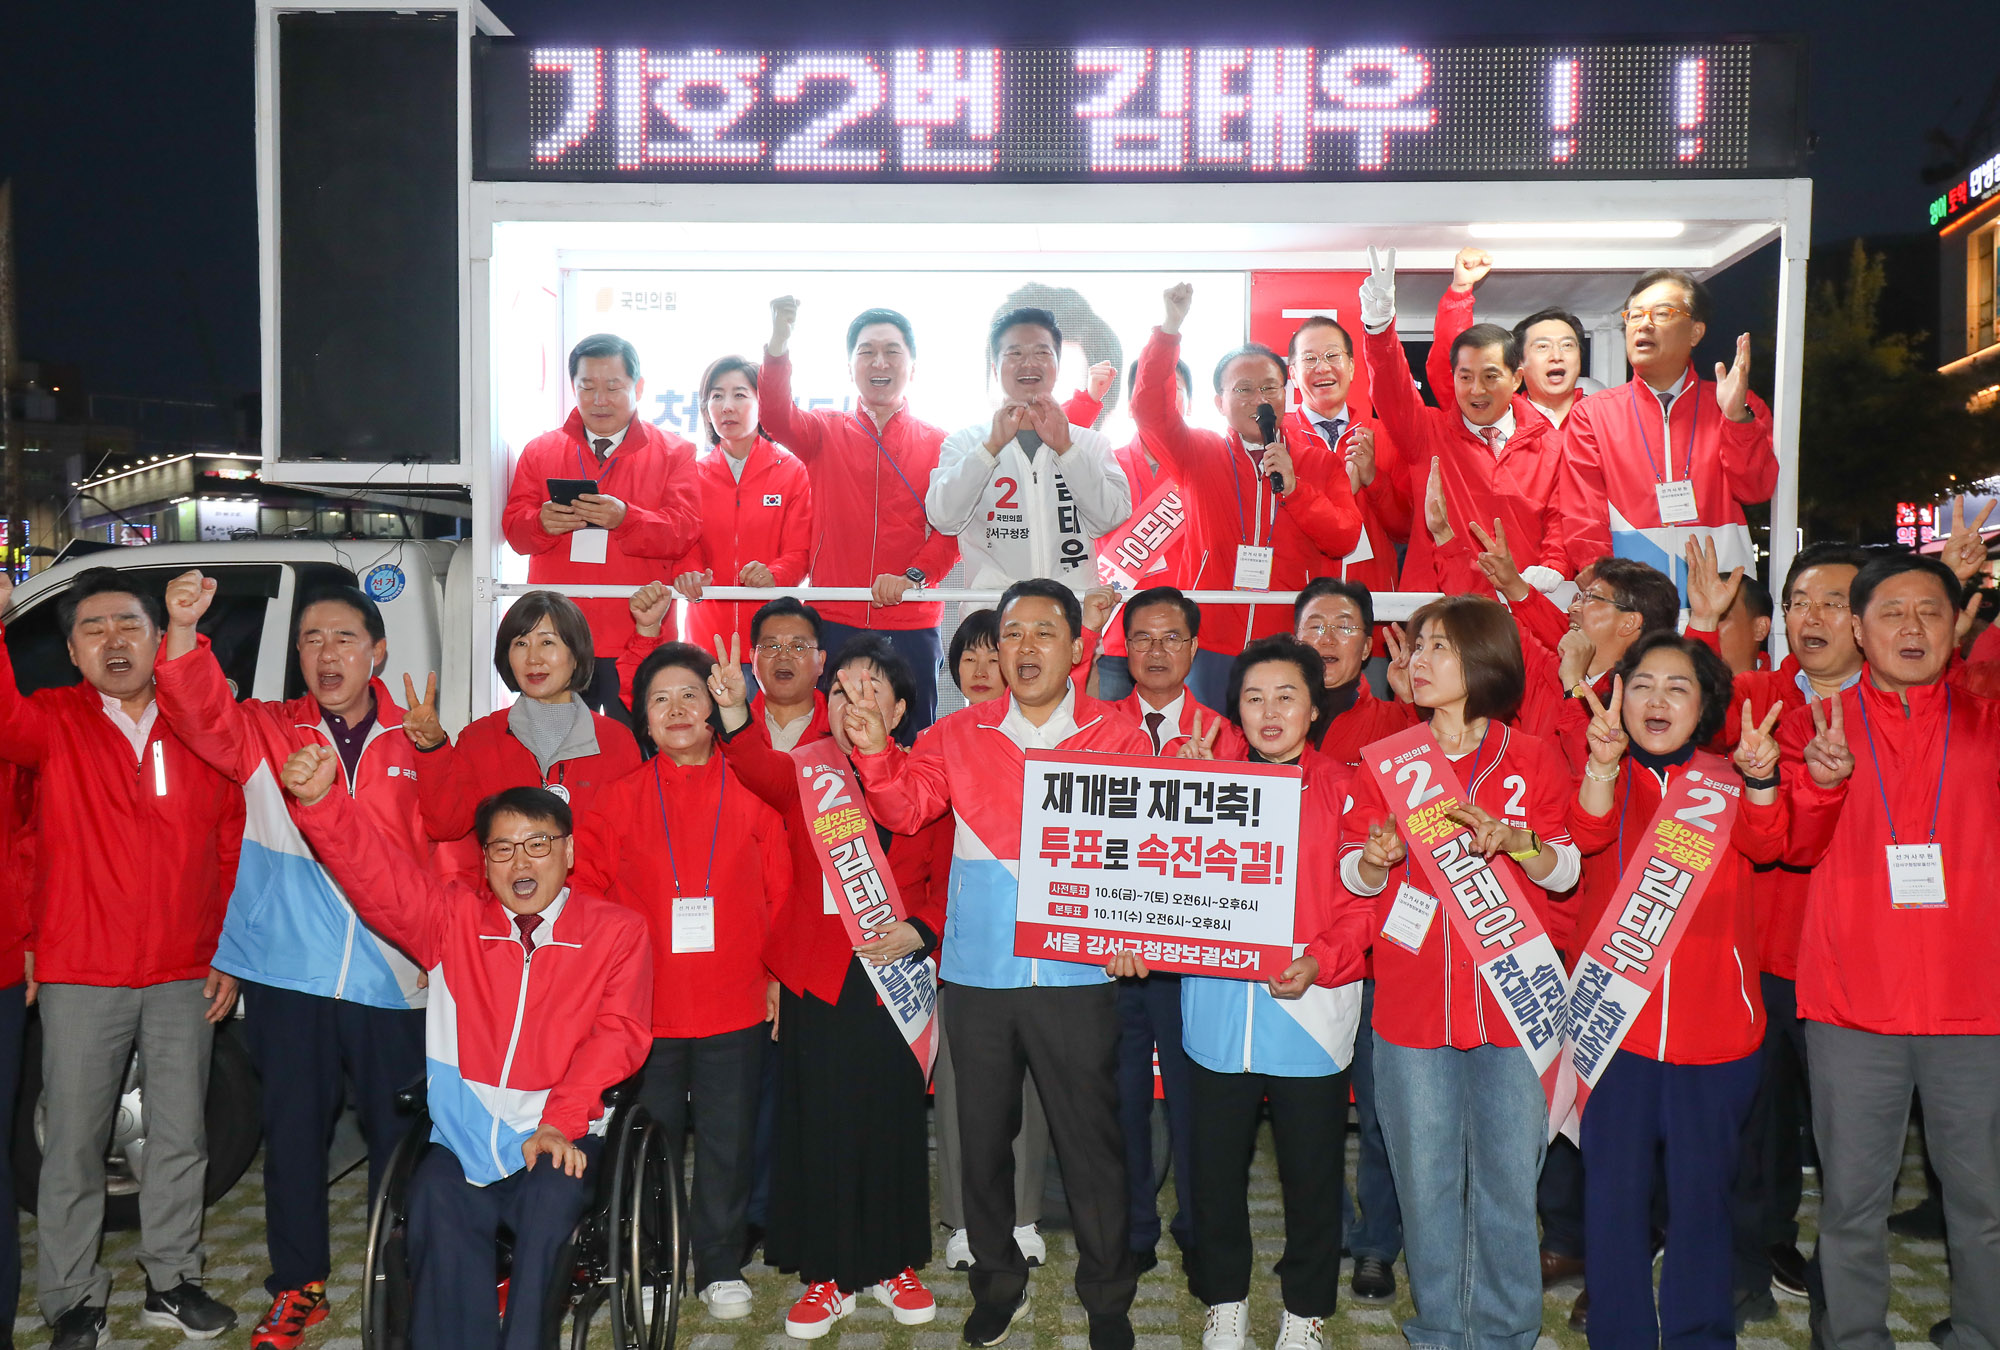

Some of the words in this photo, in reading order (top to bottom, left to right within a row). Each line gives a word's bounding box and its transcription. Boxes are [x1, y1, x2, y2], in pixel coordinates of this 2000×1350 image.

[535, 48, 999, 171] 기호2번
[1075, 46, 1437, 171] 김태우
[1930, 194, 1947, 225] 영어
[1948, 180, 1967, 213] 토익
[620, 291, 677, 311] 국민의힘
[994, 477, 1019, 509] 2
[997, 514, 1023, 522] 국민의힘
[1115, 491, 1185, 570] 김태우
[372, 578, 396, 590] 선거
[1394, 743, 1431, 765] 국민의힘
[813, 772, 852, 813] 2
[1042, 772, 1141, 819] 재개발
[1147, 779, 1262, 827] 재건축!
[1395, 760, 1445, 810] 2
[1503, 774, 1526, 817] 2
[1703, 777, 1741, 798] 국민의힘
[813, 808, 861, 835] 힘있는
[1674, 787, 1727, 833] 2
[822, 818, 867, 845] 구청장
[1420, 817, 1463, 846] 구청
[1654, 819, 1716, 855] 힘있는
[1039, 826, 1129, 870] 투표로
[1136, 833, 1285, 885] 속전속결!
[1654, 836, 1712, 872] 구청장
[829, 836, 897, 941] 김태우
[1051, 883, 1088, 897] 사전투표
[1095, 886, 1169, 905] 10.6(금)~7(토)
[1172, 893, 1259, 912] 오전6시~오후6시
[1431, 831, 1526, 949] 김태우
[1055, 904, 1083, 917] 본투표
[1094, 908, 1143, 924] 10.11(수)
[1146, 912, 1232, 931] 오전6시~오후8시
[1602, 856, 1694, 974] 김태우
[1043, 932, 1080, 953] 서울
[1086, 935, 1261, 971] 강서구청장보궐선거
[1490, 953, 1554, 1051] 첫날부터
[1572, 999, 1627, 1080] 속전속결
